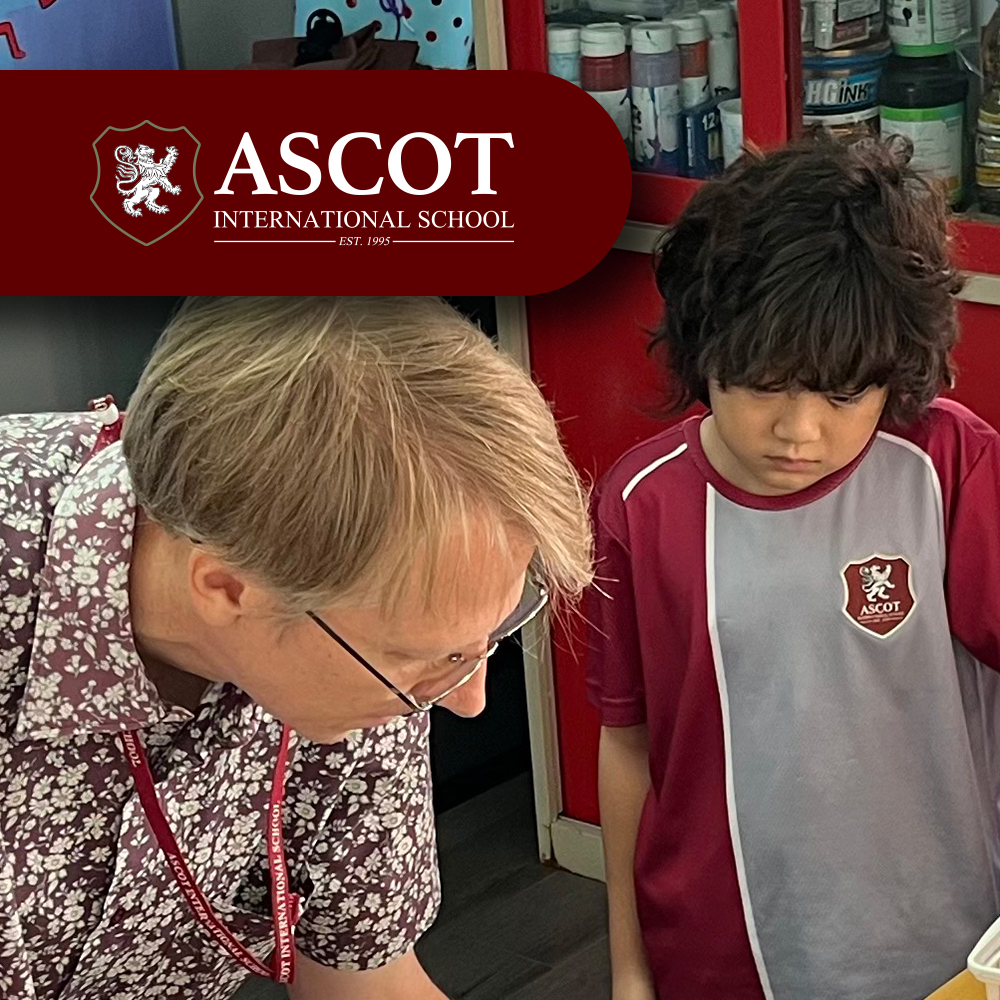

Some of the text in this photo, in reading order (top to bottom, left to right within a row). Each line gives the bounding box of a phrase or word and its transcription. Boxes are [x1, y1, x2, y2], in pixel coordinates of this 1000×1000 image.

[860, 601, 901, 616] ASCOT
[271, 801, 281, 853] SCHOOL
[167, 852, 191, 887] ASCOT
[273, 855, 291, 958] INTERNATIONAL
